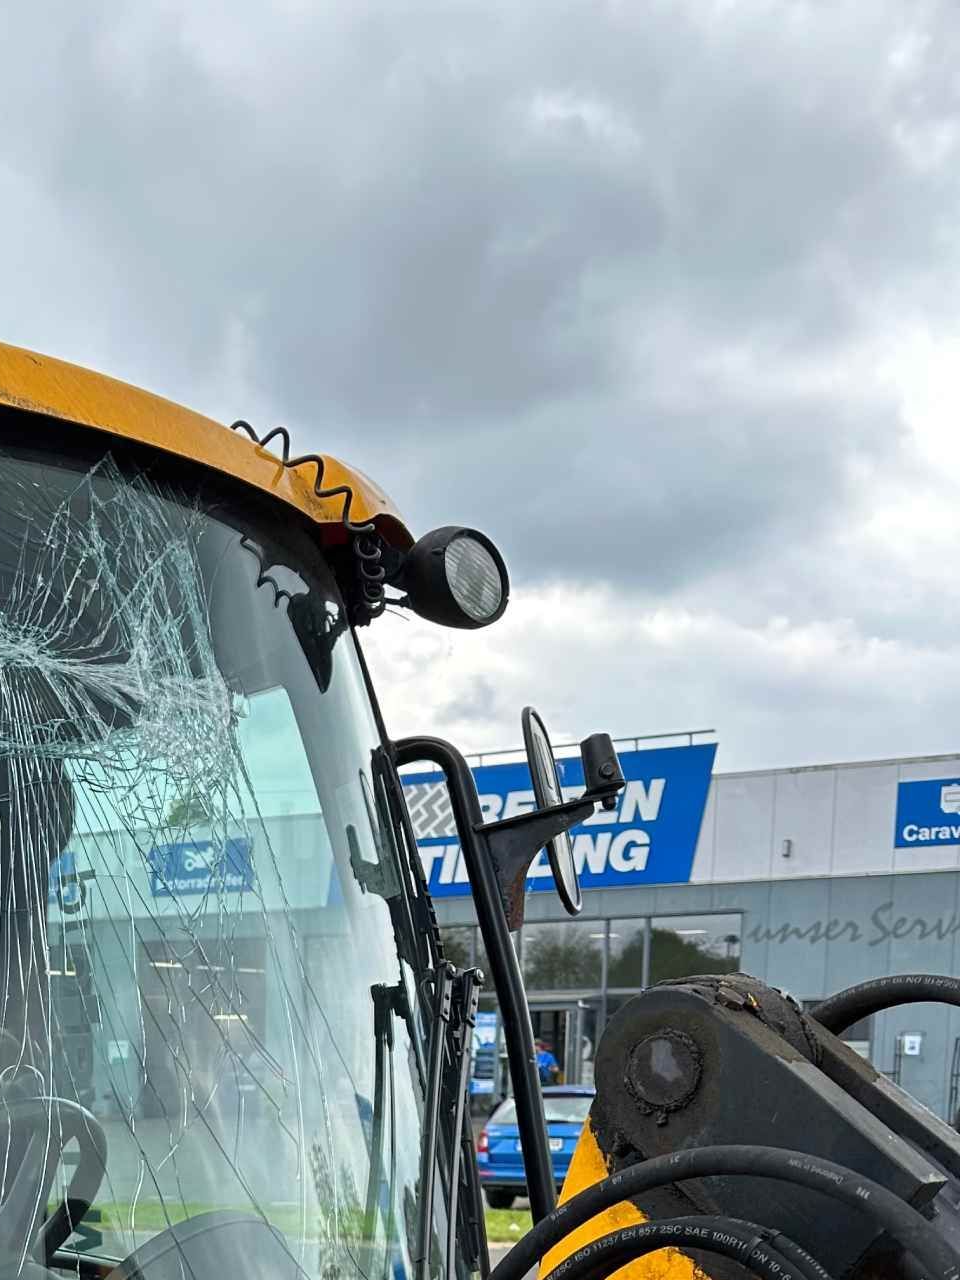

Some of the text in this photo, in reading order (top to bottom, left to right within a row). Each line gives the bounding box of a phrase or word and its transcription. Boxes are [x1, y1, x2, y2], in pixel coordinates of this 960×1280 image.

[902, 823, 960, 843] Carav
[746, 900, 960, 948] unser Serv
[683, 1226, 710, 1238] SAE
